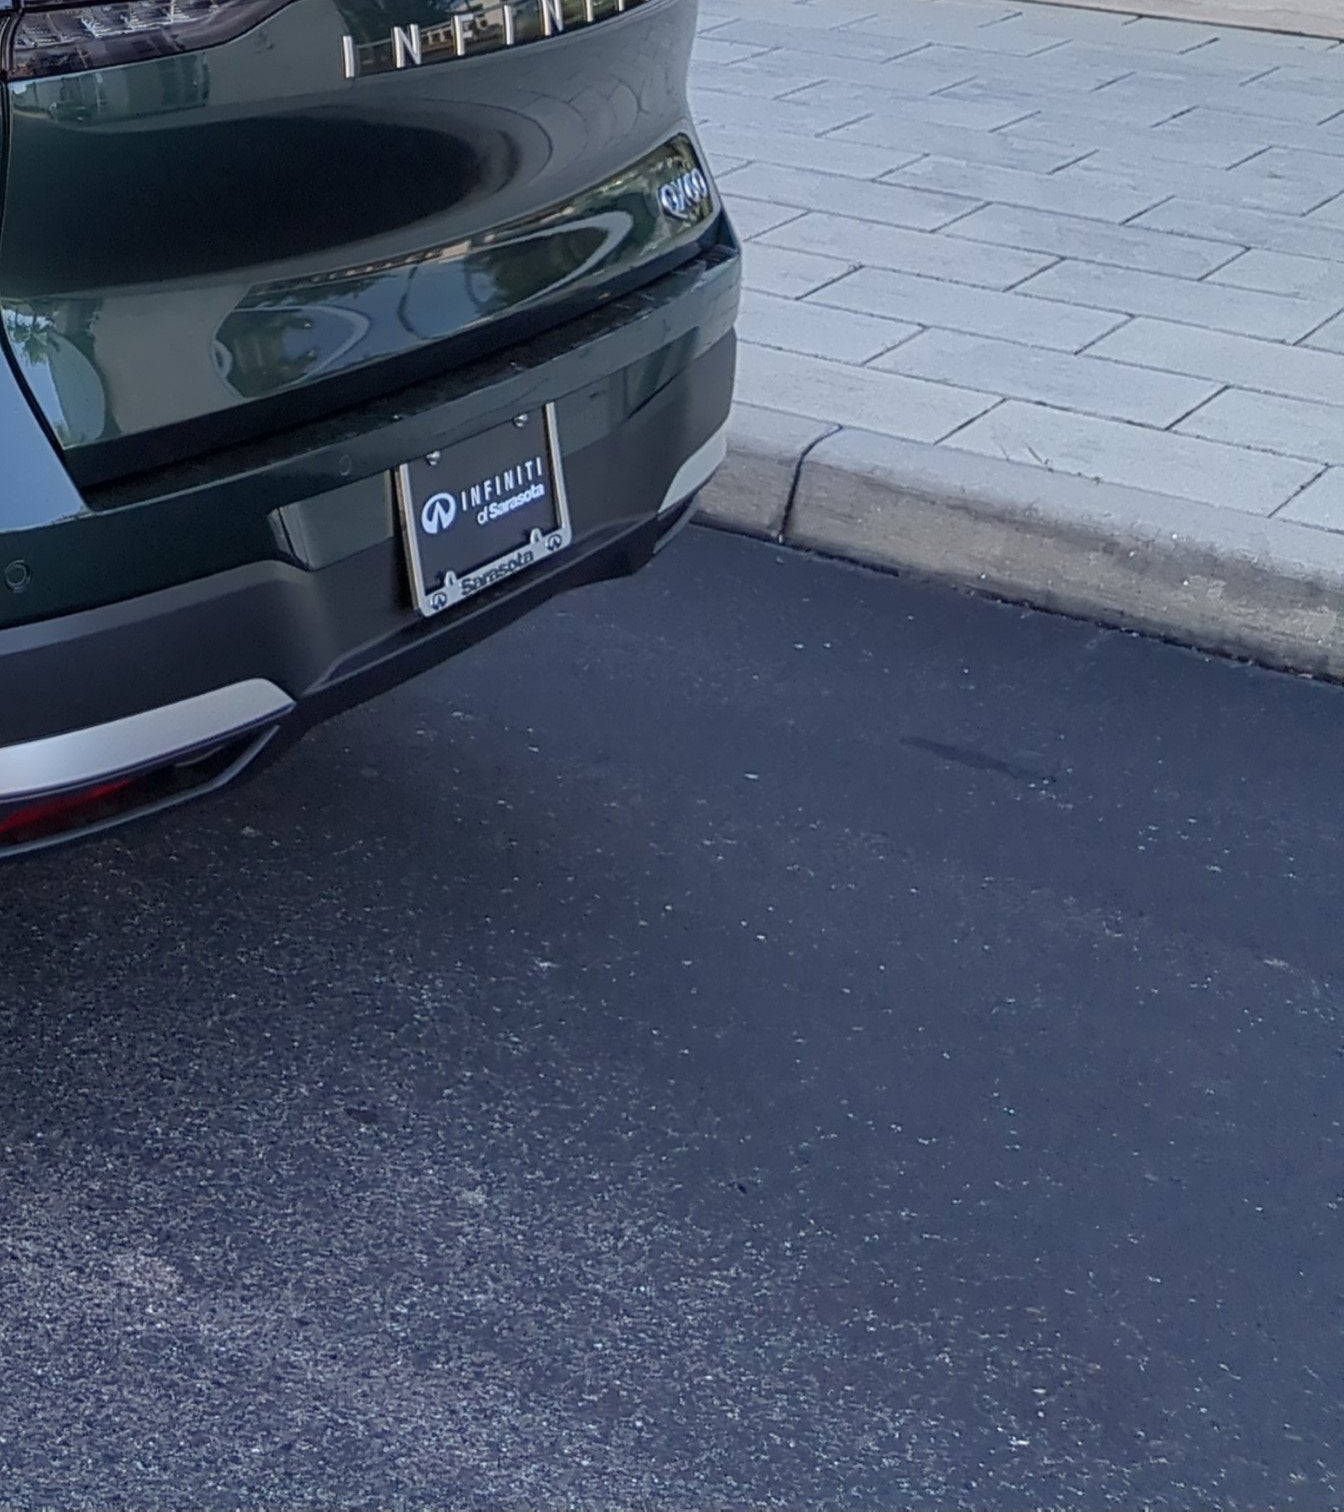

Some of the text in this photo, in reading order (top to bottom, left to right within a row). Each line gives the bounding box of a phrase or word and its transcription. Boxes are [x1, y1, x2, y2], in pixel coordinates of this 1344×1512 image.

[461, 456, 543, 512] INFINITI
[489, 483, 545, 518] Sarasota
[461, 550, 534, 596] Sarasota
